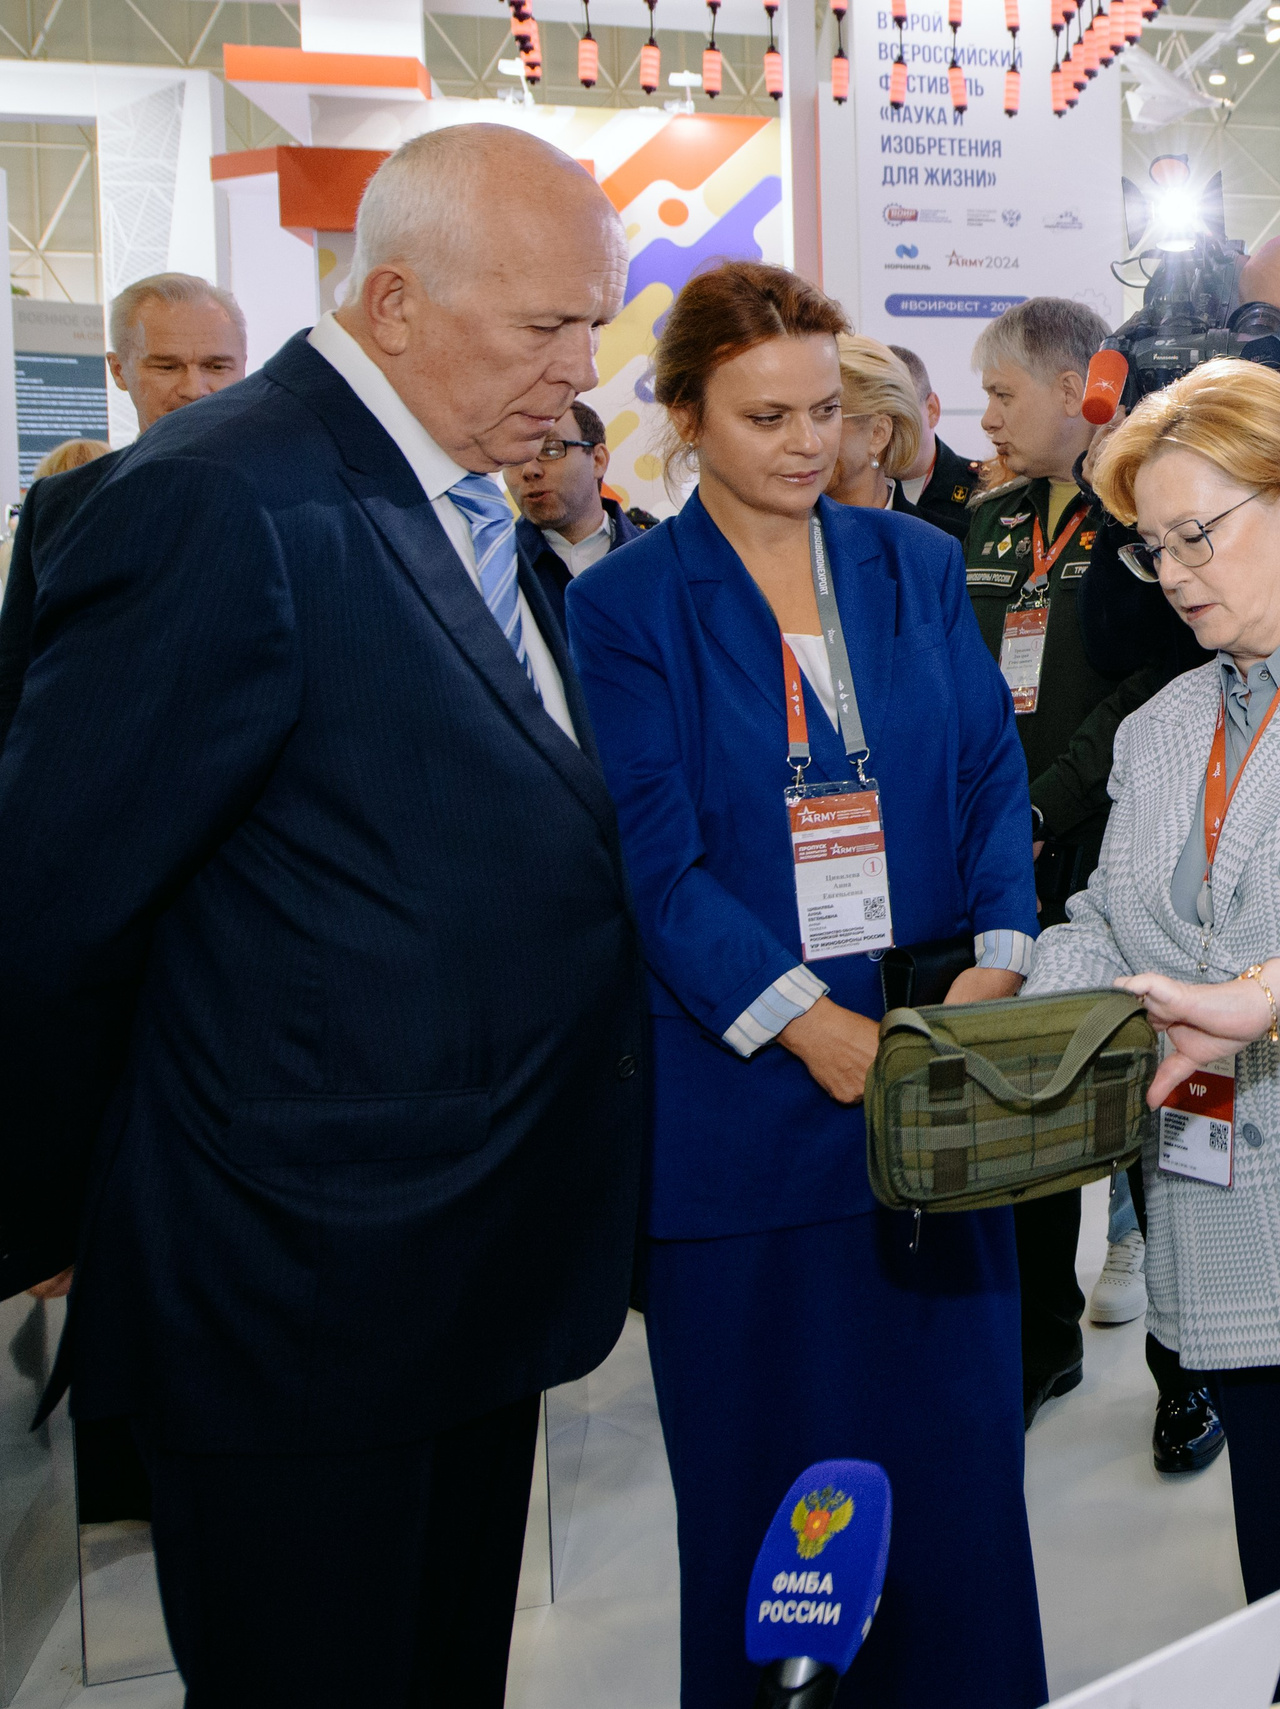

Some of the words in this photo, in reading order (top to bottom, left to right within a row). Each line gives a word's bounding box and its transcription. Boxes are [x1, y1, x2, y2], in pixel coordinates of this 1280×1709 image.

[878, 42, 1023, 68] ВСЕРОССИЙСКИЙ
[879, 73, 984, 96] ФСТИВЛЬ
[880, 105, 947, 126] «НАУКА
[880, 135, 1002, 158] ИЗОБРЕТЕНИЯ
[881, 165, 919, 187] ДЛЯ
[924, 167, 997, 187] ЖИЗНИ»
[901, 301, 980, 312] #ВОИРФЕСТ
[813, 525, 830, 596] ROSOBORONEXPORT
[870, 861, 876, 873] 1
[1189, 1082, 1208, 1097] VIP
[771, 1570, 834, 1595] ФМБА
[758, 1599, 842, 1626] РОССИИ
